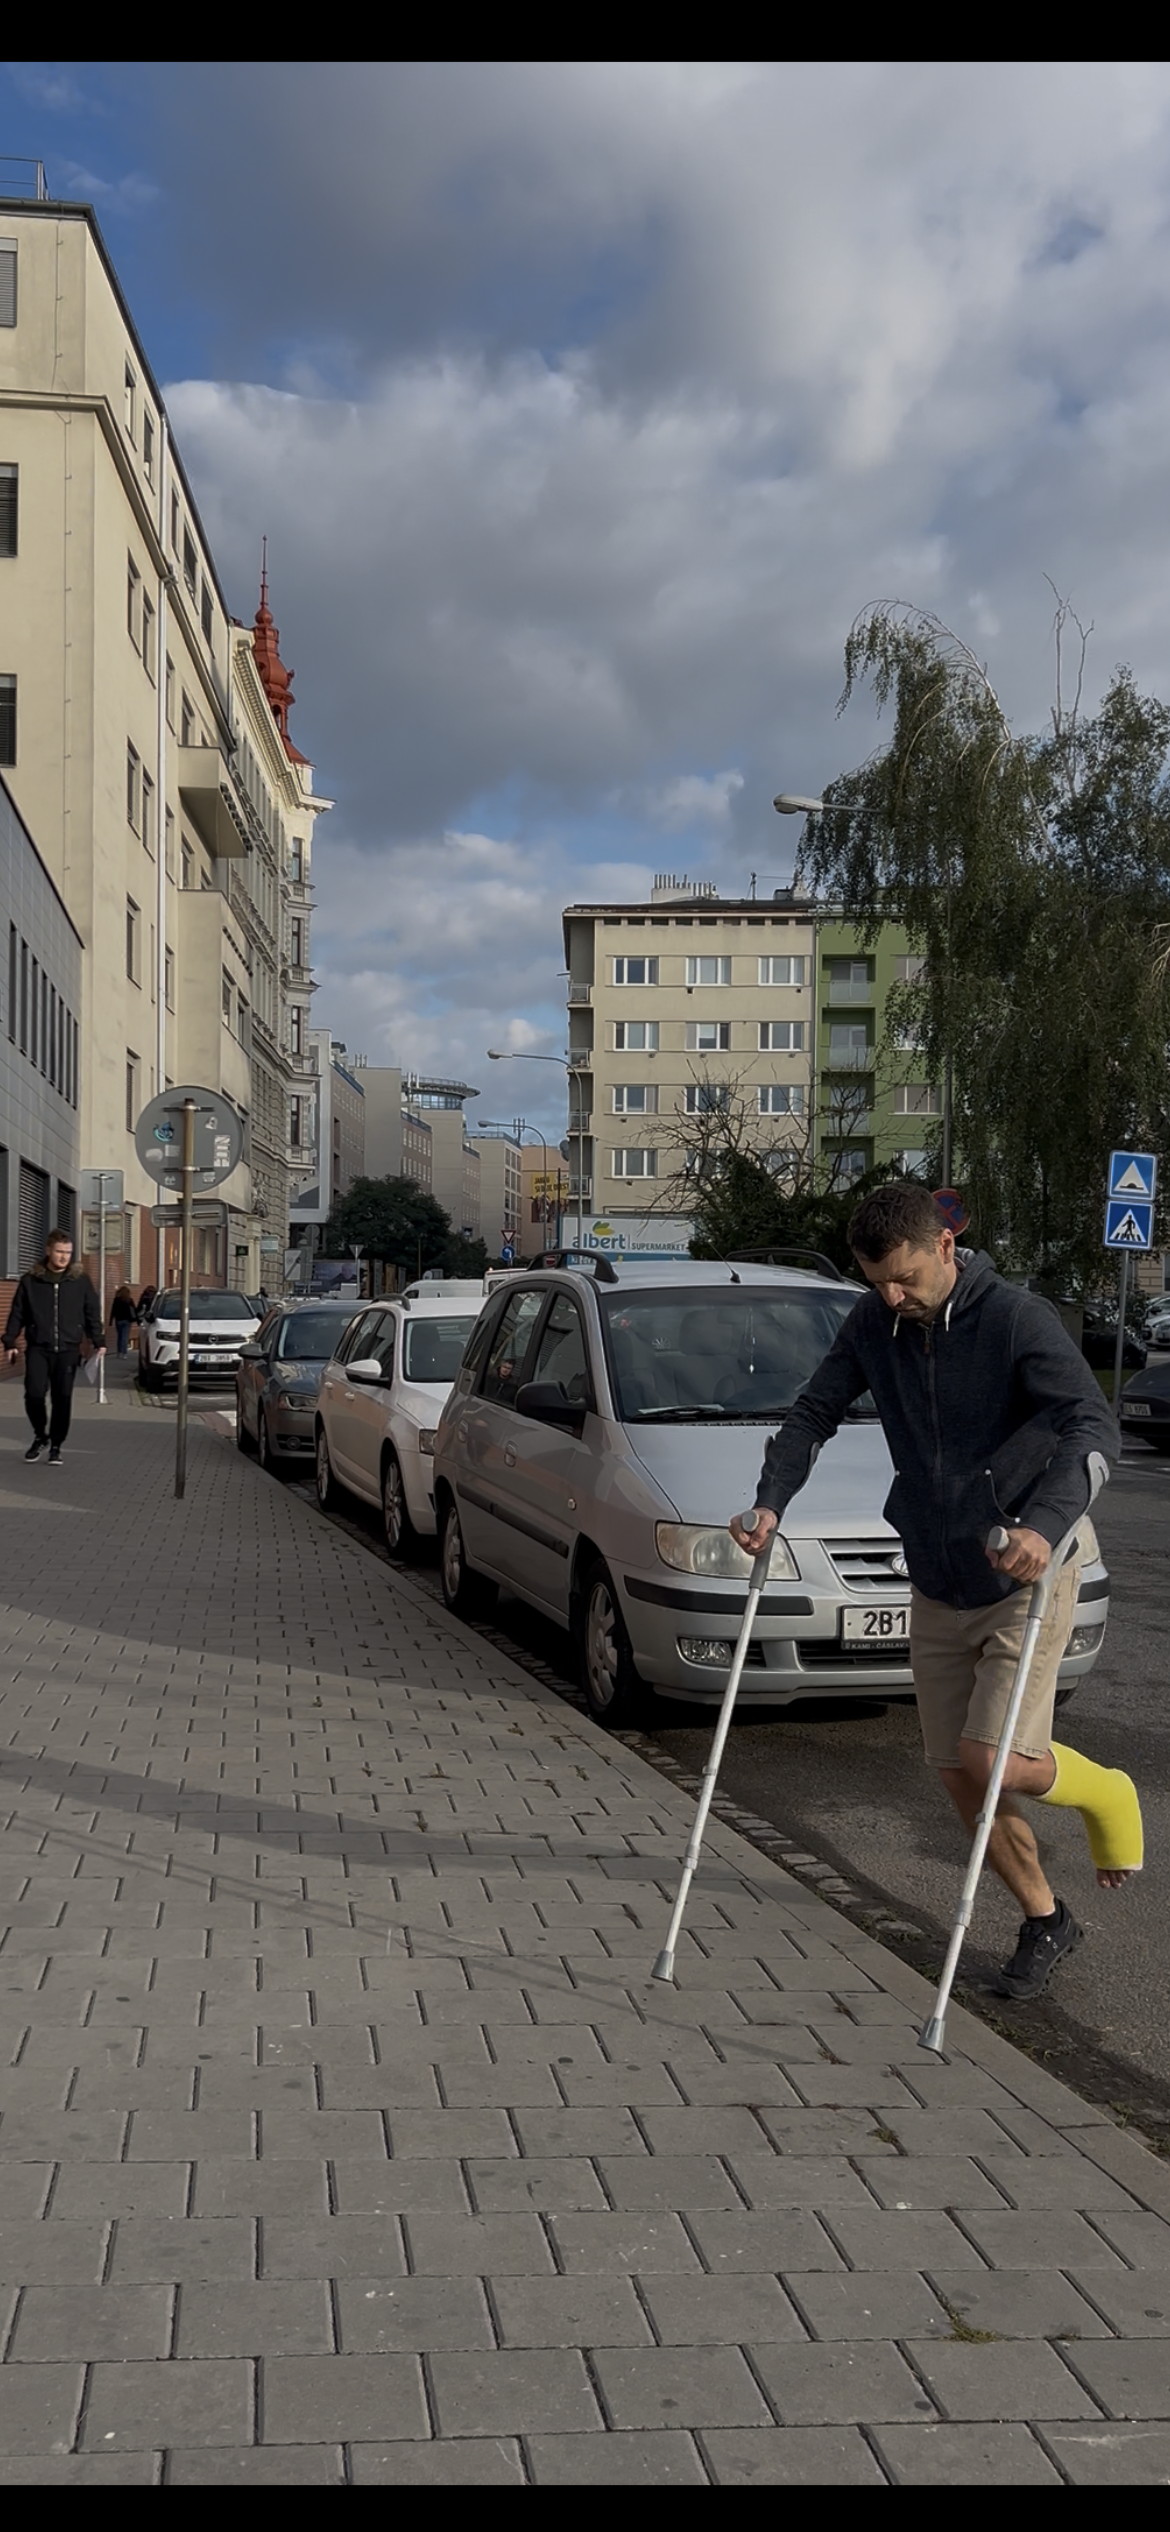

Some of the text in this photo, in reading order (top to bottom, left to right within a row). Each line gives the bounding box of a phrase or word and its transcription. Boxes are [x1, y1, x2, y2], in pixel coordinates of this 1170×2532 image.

[572, 1233, 686, 1251] albert SUPERMARKET
[863, 1610, 907, 1636] 2B1
